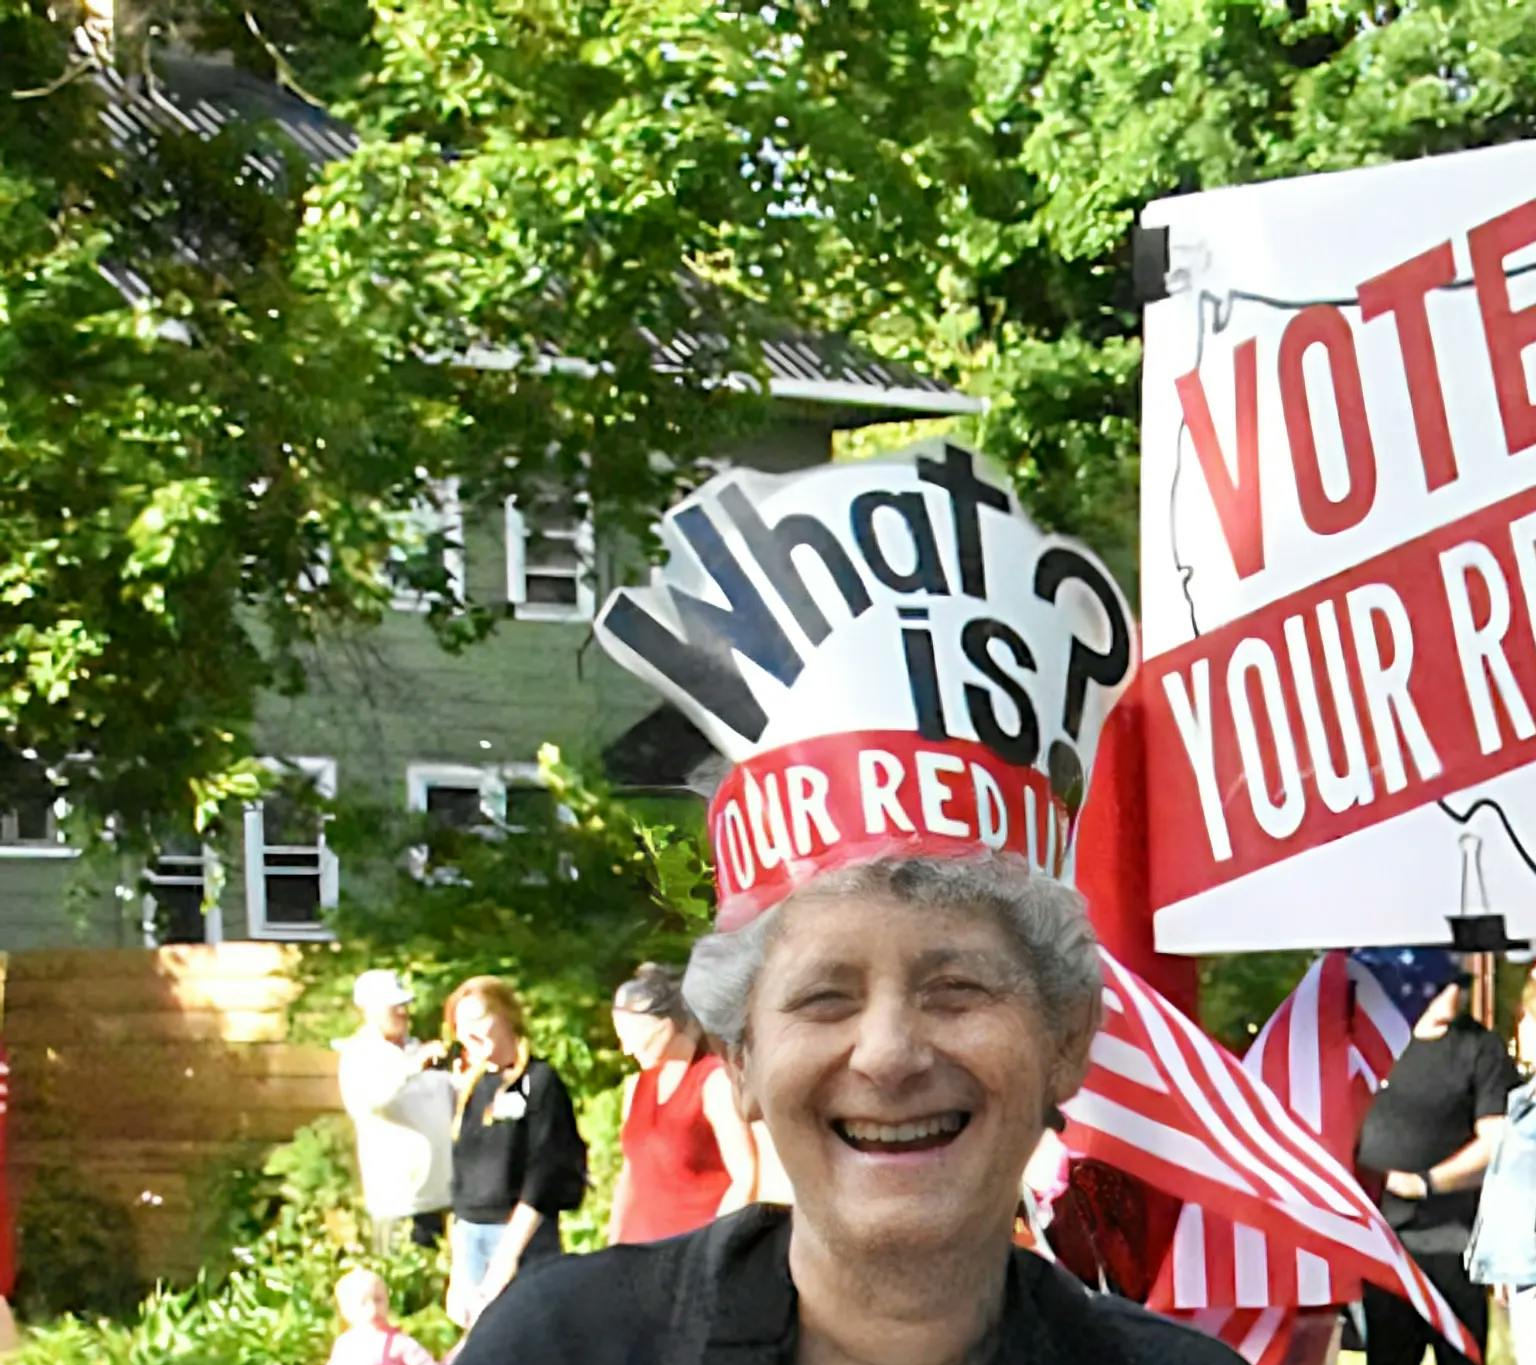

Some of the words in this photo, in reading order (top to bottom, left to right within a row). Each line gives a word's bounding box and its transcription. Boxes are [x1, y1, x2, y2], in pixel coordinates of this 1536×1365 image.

[602, 442, 1012, 742] What
[1162, 580, 1443, 862] YOUR
[716, 765, 841, 899] OUR
[858, 749, 1008, 850] RED
